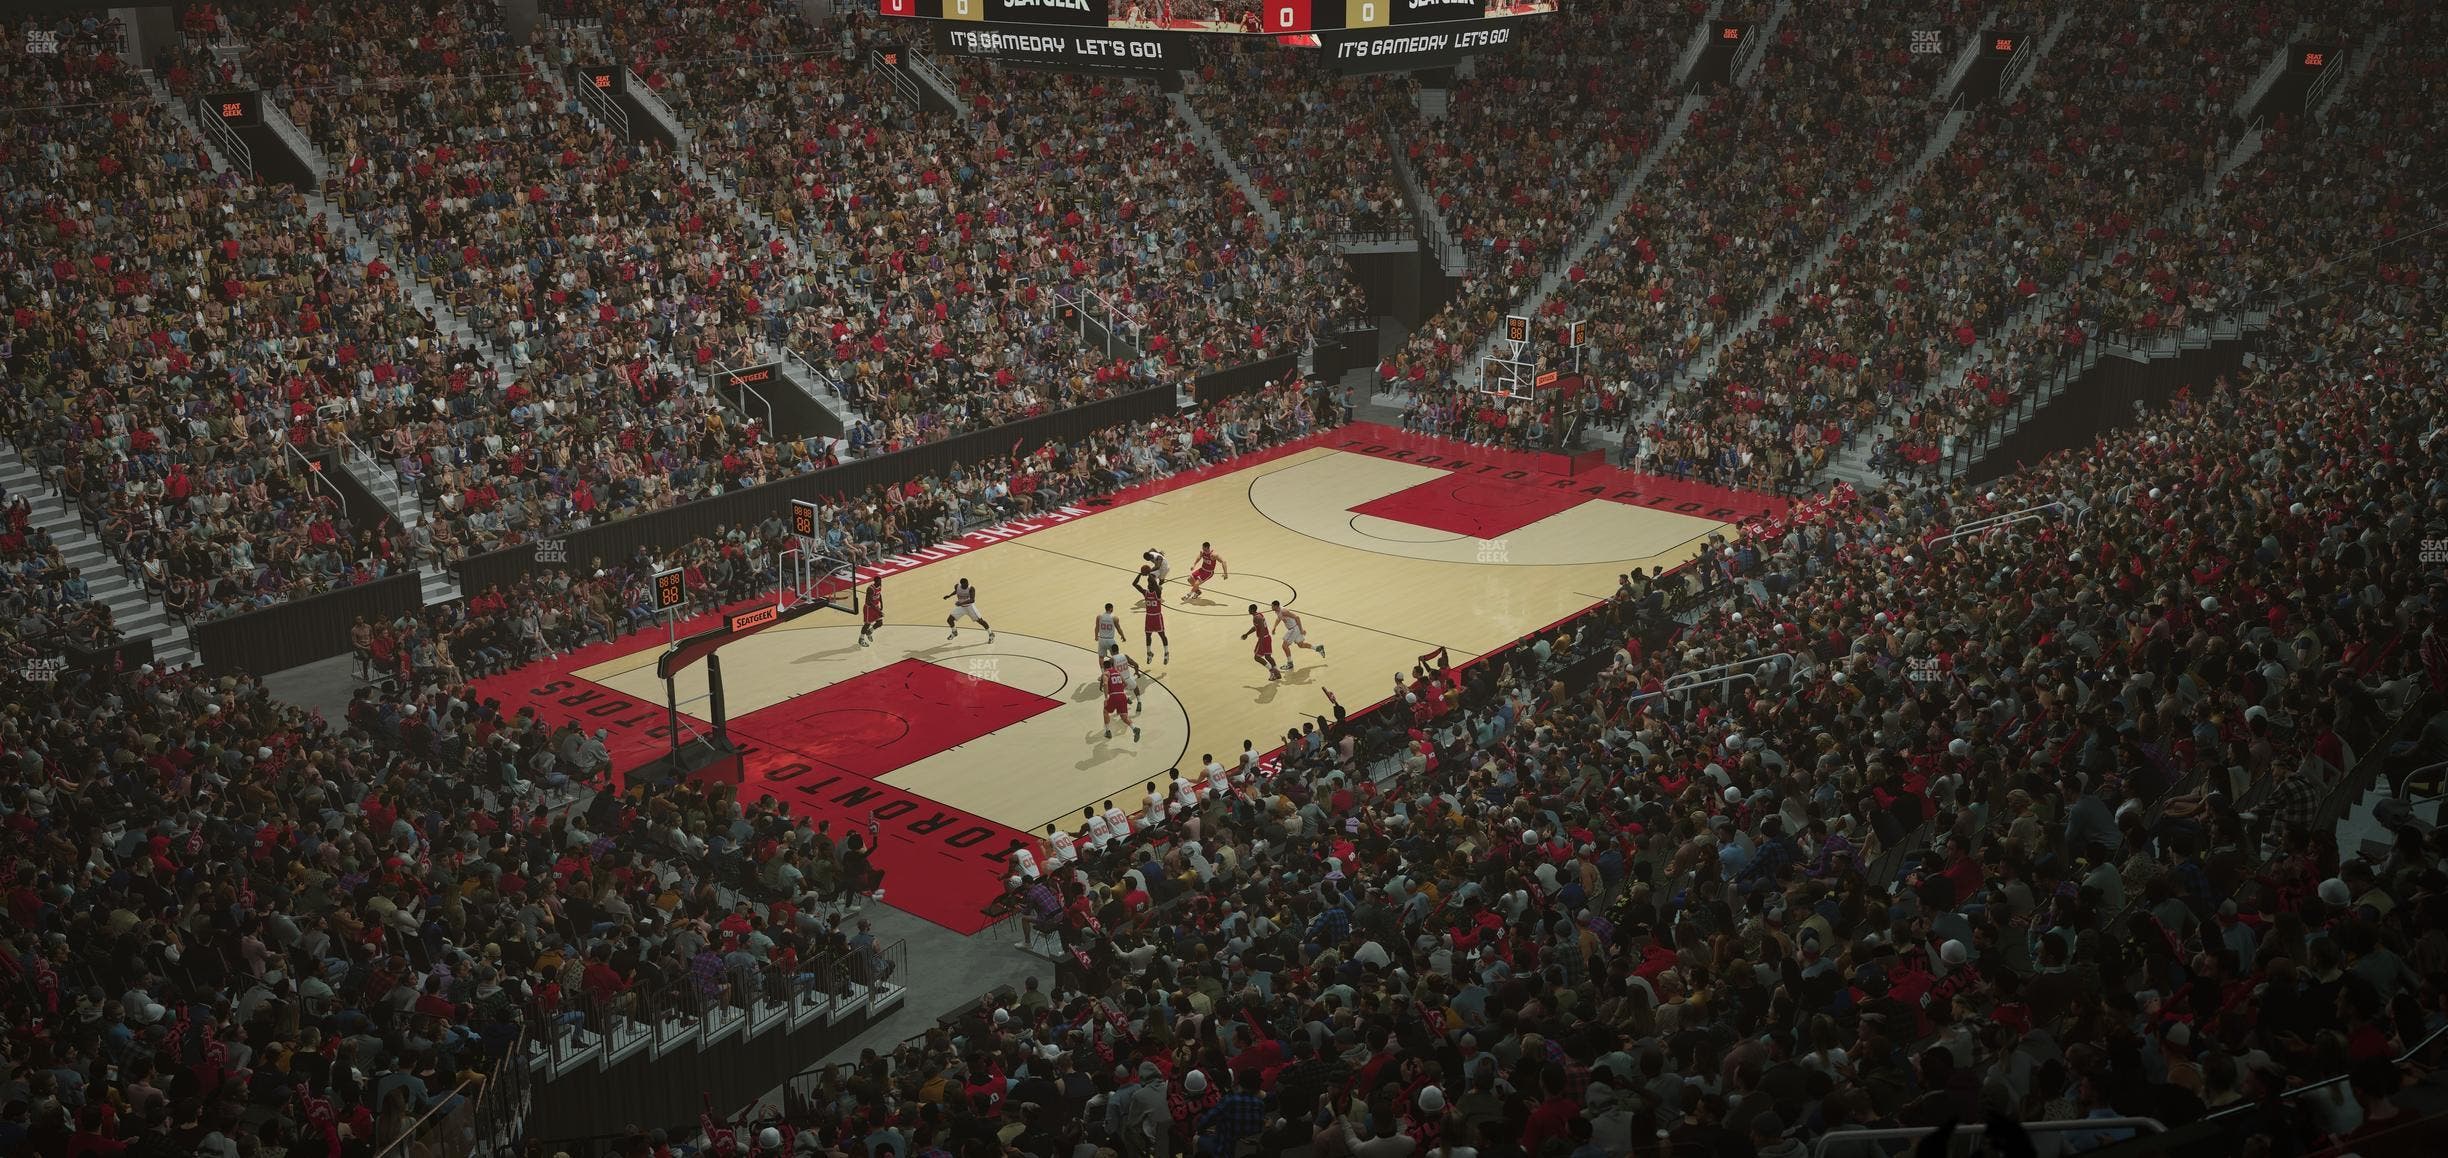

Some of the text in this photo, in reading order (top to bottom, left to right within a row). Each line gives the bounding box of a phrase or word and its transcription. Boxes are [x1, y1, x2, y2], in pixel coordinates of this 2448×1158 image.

[1280, 8, 1294, 27] 0
[1362, 3, 1375, 22] 0
[950, 31, 1163, 58] IT'S GAMEDAY LET'S GO!
[1337, 28, 1510, 58] IT'S GAMEDAY LET'S GO!
[222, 109, 242, 118] GEEK
[1511, 327, 1523, 340] 88
[796, 516, 811, 534] 88
[961, 521, 1044, 543] THE
[662, 586, 679, 605] 88
[736, 610, 773, 629] SEATGEEK
[764, 763, 1030, 864] TORONTO
[722, 929, 734, 938] 00
